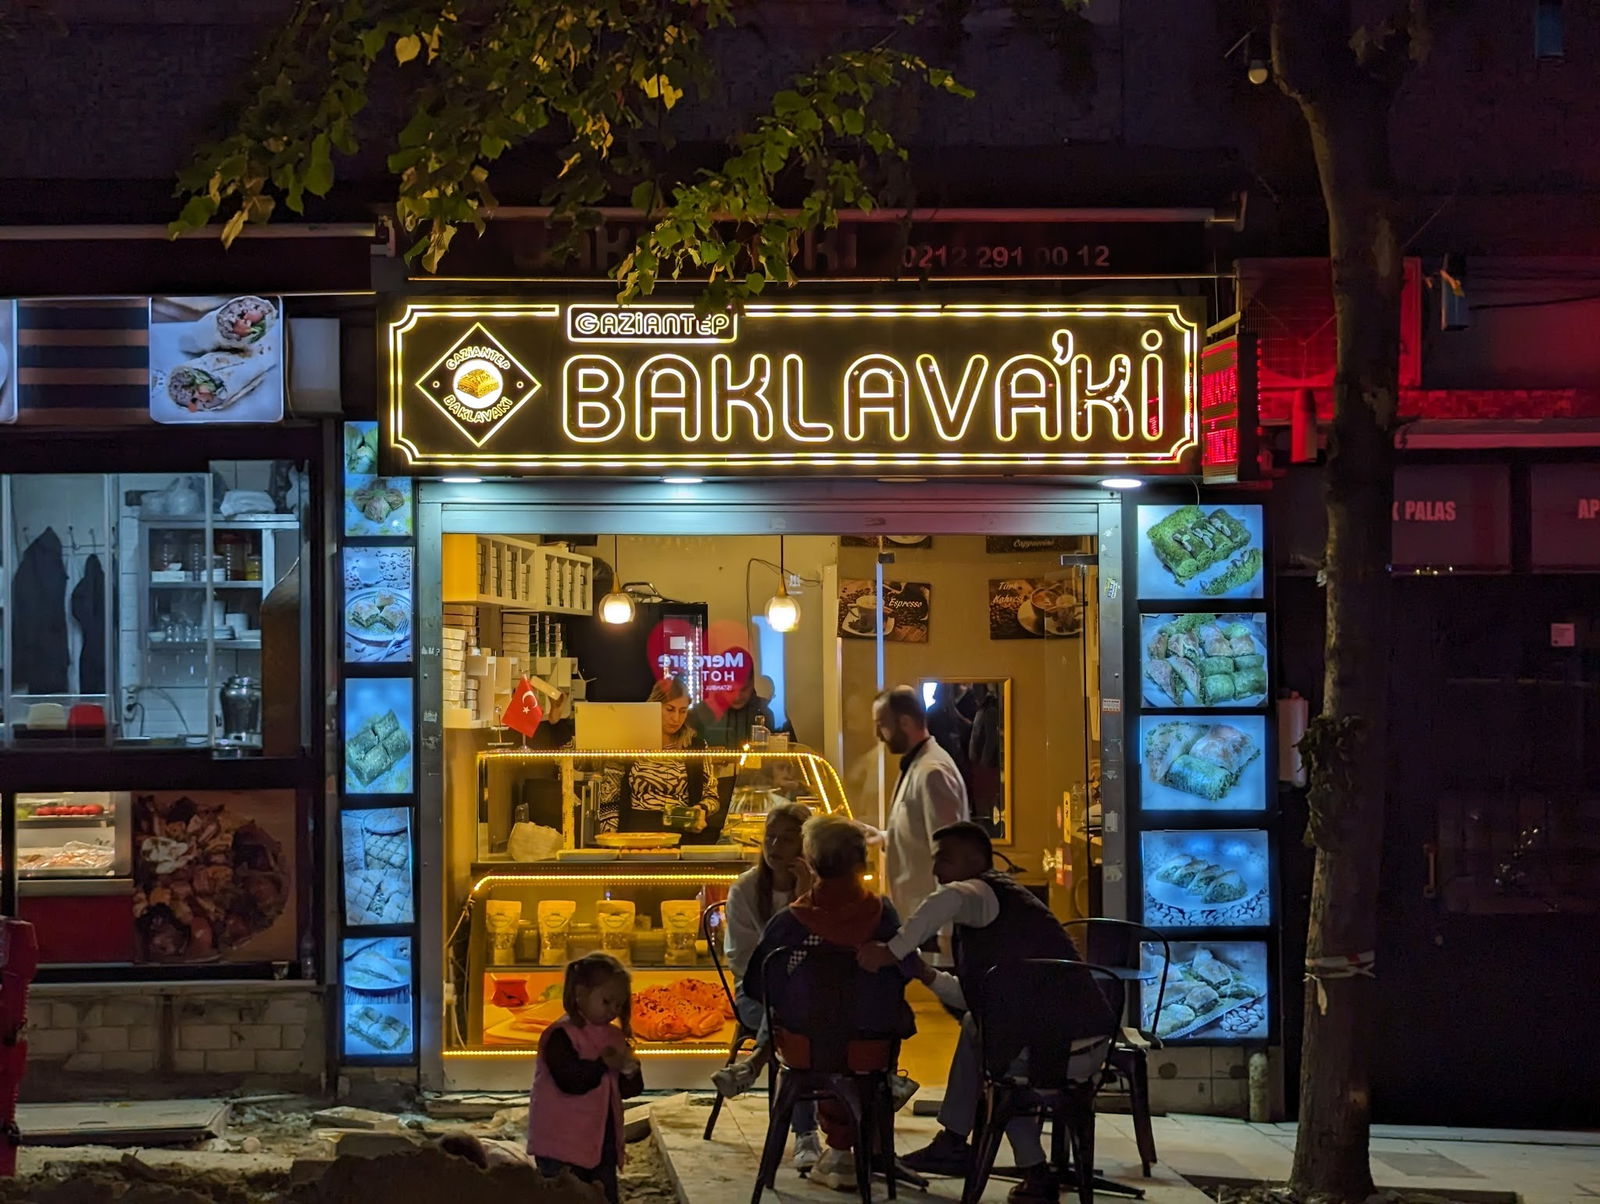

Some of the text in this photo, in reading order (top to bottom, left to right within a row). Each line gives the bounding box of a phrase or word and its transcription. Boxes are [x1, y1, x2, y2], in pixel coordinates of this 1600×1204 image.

[903, 244, 968, 268] 0212
[976, 245, 1022, 268] 291
[1077, 244, 1110, 267] 12
[1404, 501, 1456, 521] PALAS
[888, 598, 923, 609] Espresso
